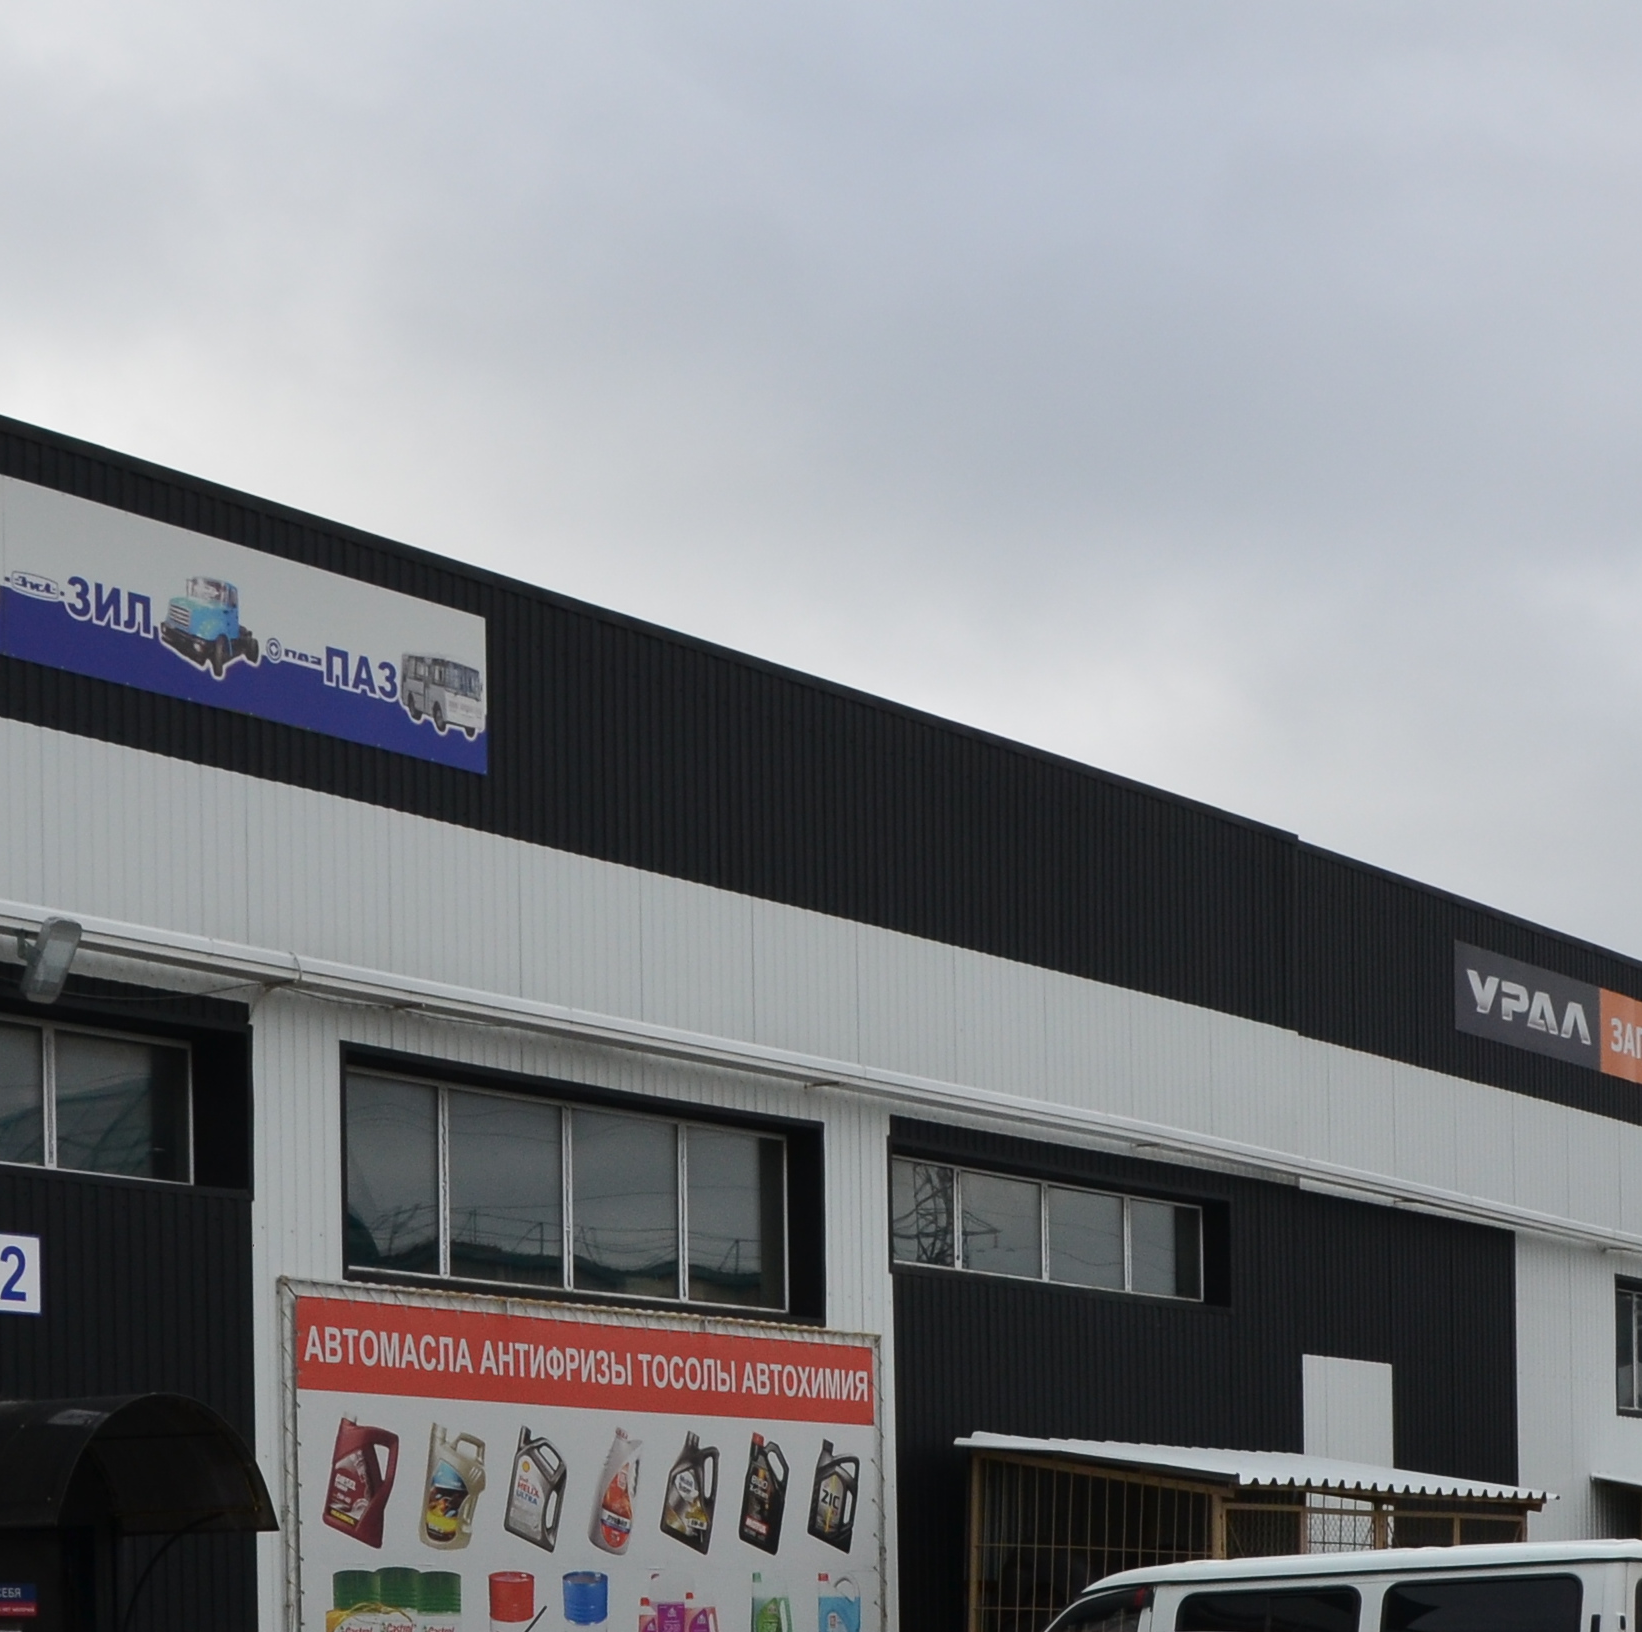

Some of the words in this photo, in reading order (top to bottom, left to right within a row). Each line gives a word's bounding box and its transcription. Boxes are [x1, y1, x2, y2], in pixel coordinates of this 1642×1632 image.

[67, 577, 152, 636] ЗИЛ
[325, 647, 398, 699] ПАЗ
[1467, 969, 1592, 1045] УРАЛ
[0, 1246, 26, 1301] 2
[304, 1326, 473, 1375] АВТОМАСЛА
[480, 1340, 632, 1386] АНТИФРИЗЫ
[638, 1354, 736, 1393] ТОСОЛЫ
[742, 1360, 869, 1402] АВТОХИМИЯ
[516, 1491, 538, 1505] ULTRA
[518, 1481, 540, 1498] HELIX
[820, 1489, 841, 1509] ZIC
